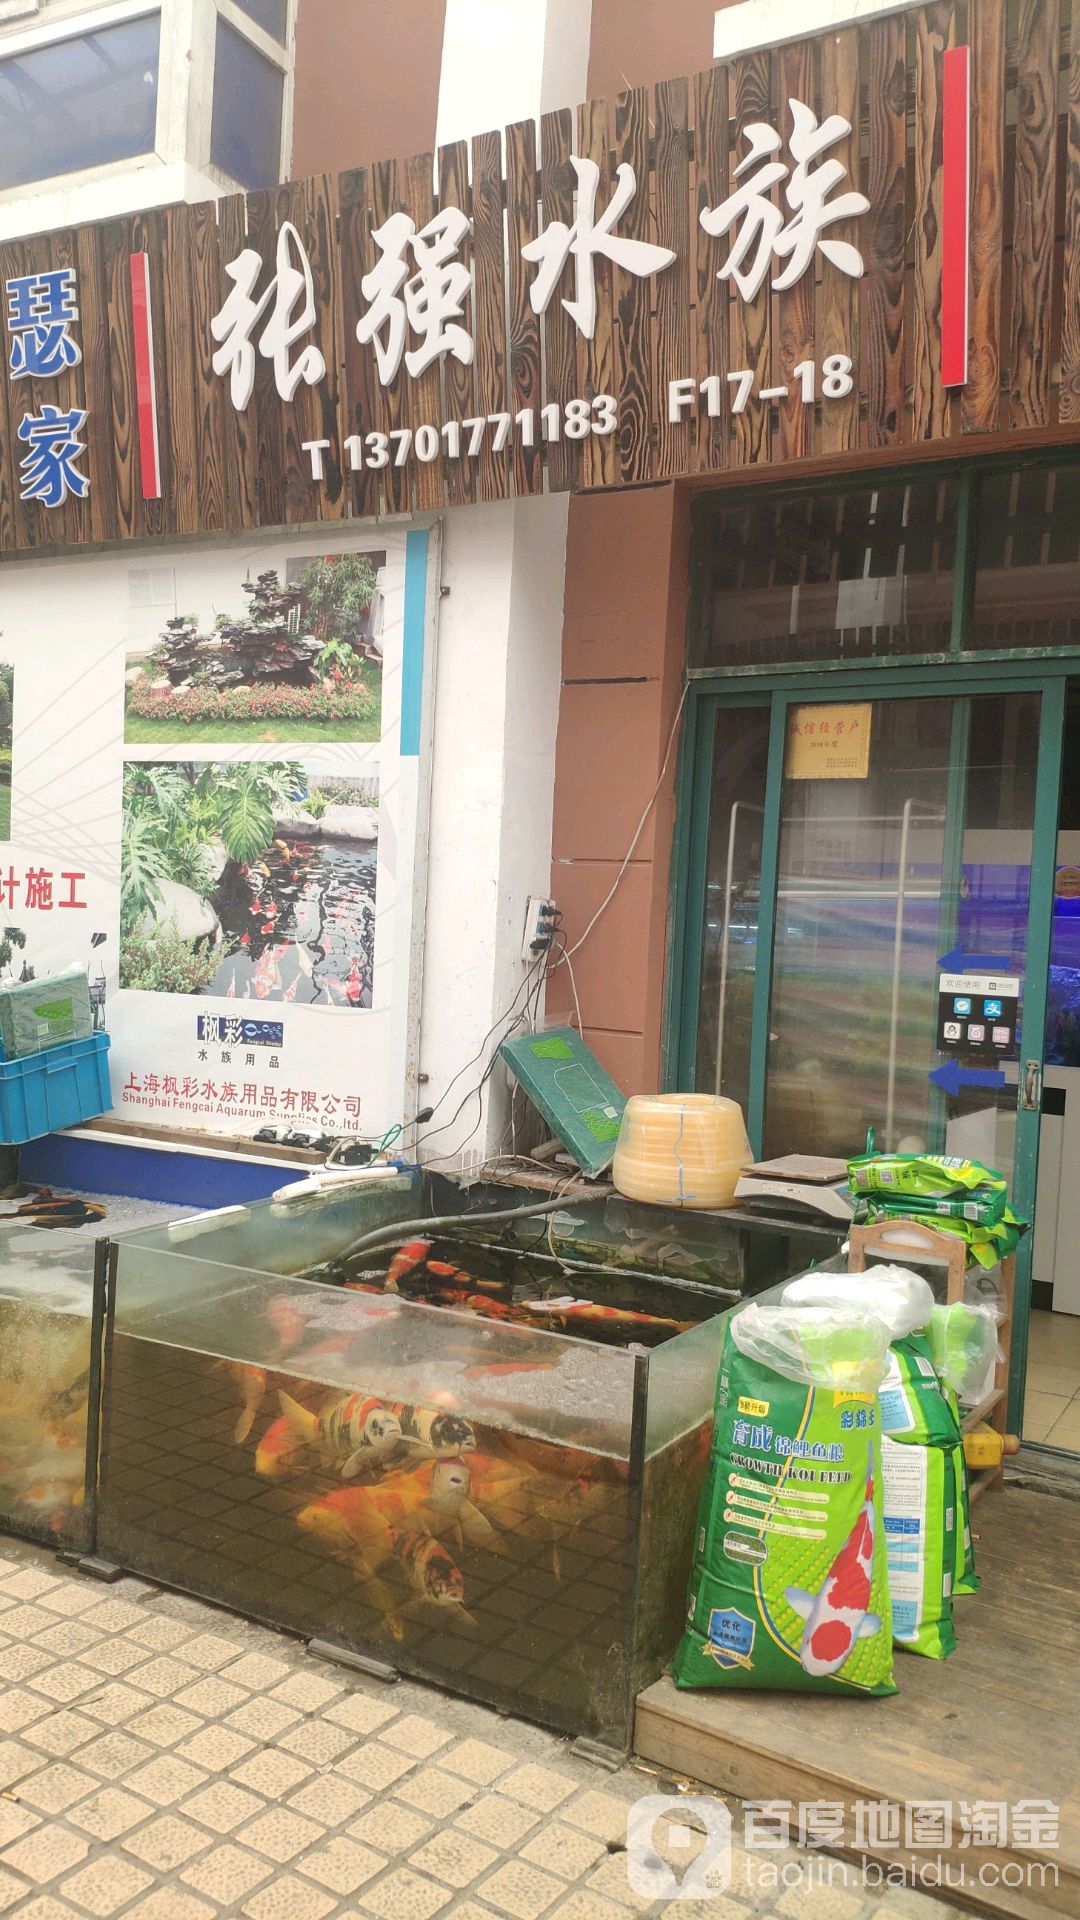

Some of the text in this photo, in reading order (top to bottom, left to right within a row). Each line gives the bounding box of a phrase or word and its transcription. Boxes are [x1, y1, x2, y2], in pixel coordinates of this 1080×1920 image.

[211, 98, 870, 412] 张强水族
[669, 354, 853, 423] F17-18
[302, 395, 617, 481] T 13701771183
[202, 1011, 243, 1048] 枫彩
[197, 1049, 279, 1068] 水族用品
[122, 1092, 170, 1107] Shanghai
[173, 1098, 213, 1112] Fengcai
[124, 1072, 361, 1118] 上海枫彩水族用品有限公司
[733, 1420, 773, 1451] 育成
[730, 1453, 784, 1477] GROWTH
[788, 1467, 816, 1481] KOI
[722, 1619, 741, 1631] 优化
